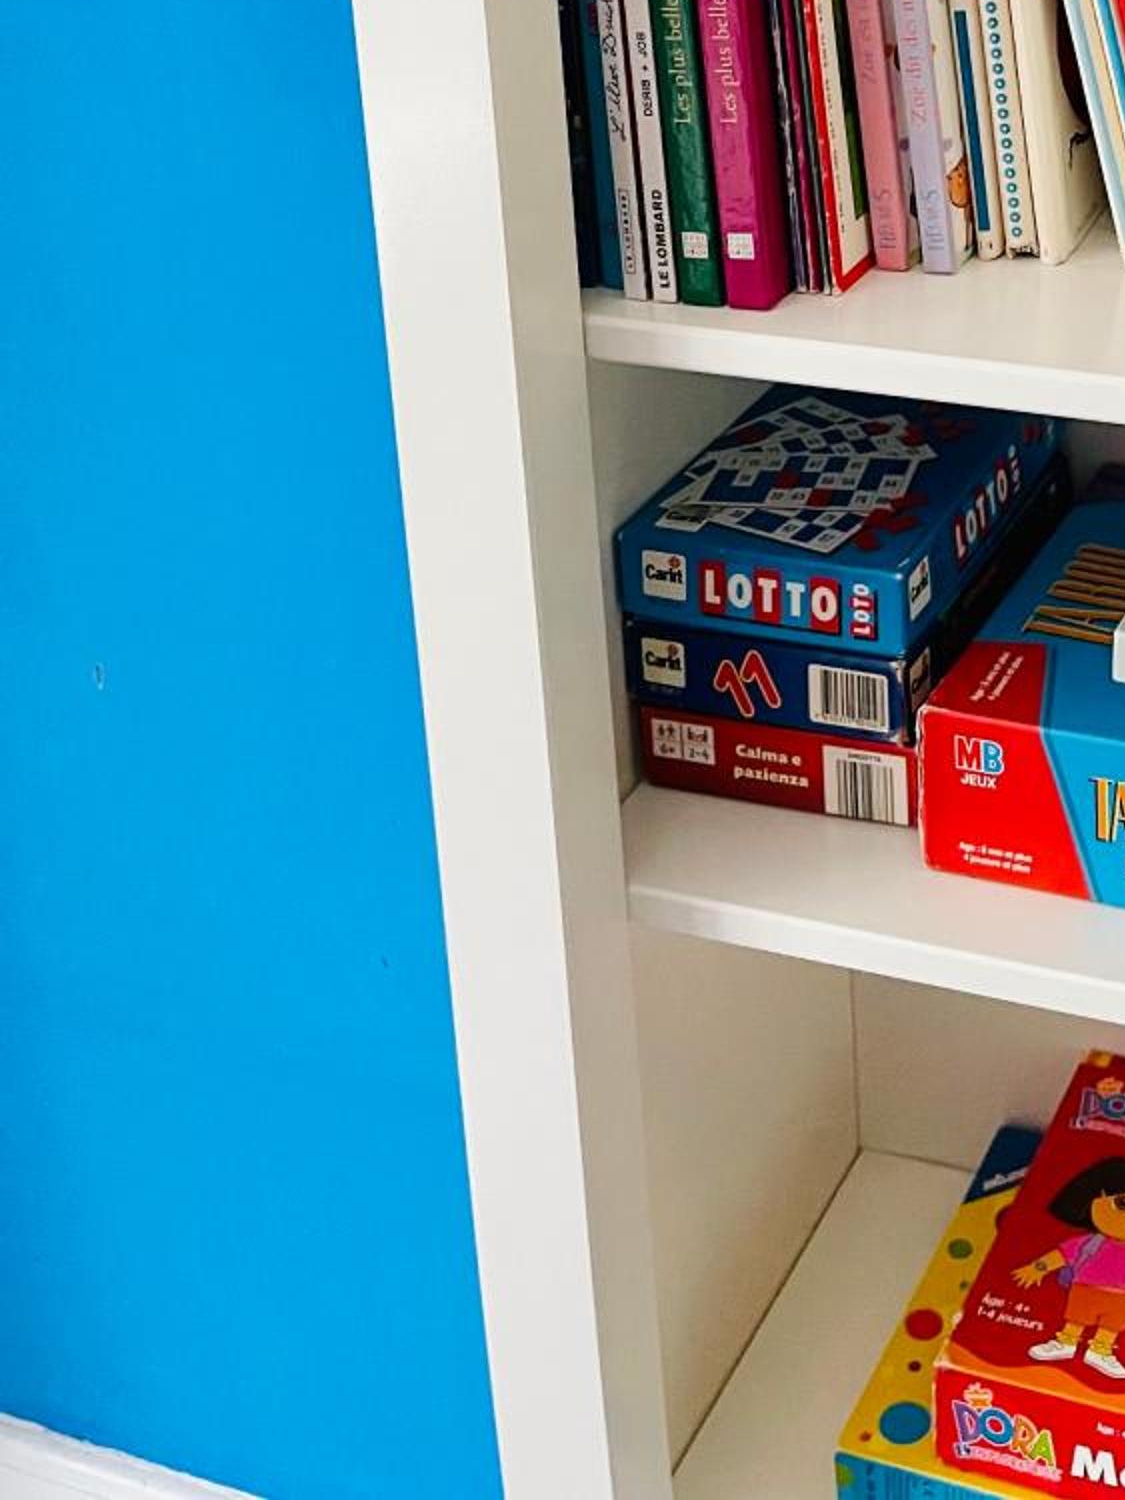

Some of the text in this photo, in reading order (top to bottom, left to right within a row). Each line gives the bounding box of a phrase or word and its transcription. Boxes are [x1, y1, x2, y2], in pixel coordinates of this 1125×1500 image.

[635, 32, 647, 58] JOB
[668, 48, 693, 96] plus
[714, 47, 741, 96] plus
[643, 79, 654, 118] DERIB
[673, 93, 692, 126] Les
[720, 90, 738, 126] Les
[651, 189, 671, 290] LE LOMBARD
[955, 468, 1009, 560] LOTTO
[703, 568, 840, 623] LOTTO
[852, 582, 872, 636] LOTO
[713, 648, 783, 718] 11
[735, 743, 802, 767] Calma e
[953, 734, 1005, 775] MB
[733, 766, 809, 788] pazienza
[960, 772, 998, 789] JEUX
[951, 1398, 1058, 1471] DORA
